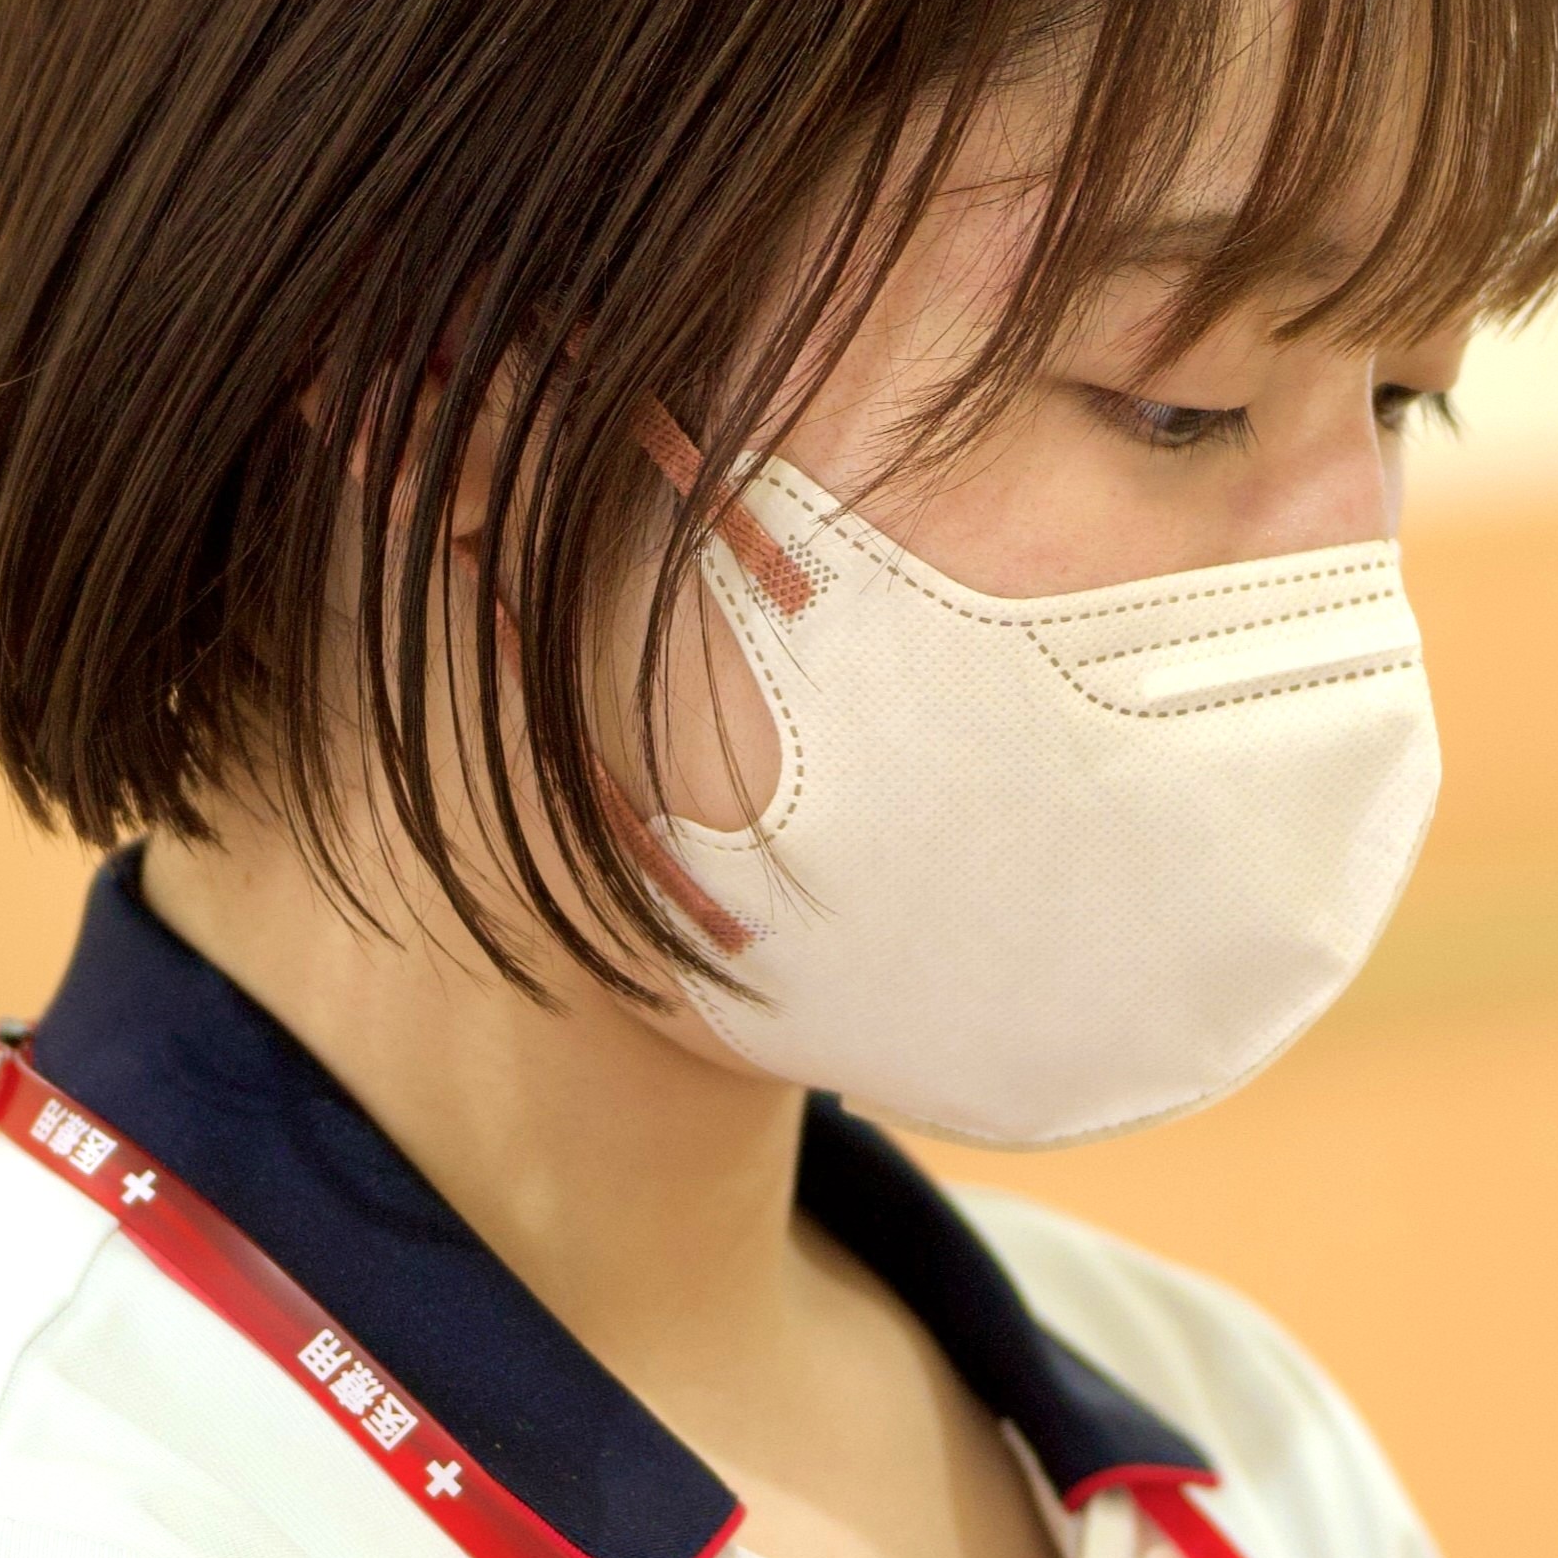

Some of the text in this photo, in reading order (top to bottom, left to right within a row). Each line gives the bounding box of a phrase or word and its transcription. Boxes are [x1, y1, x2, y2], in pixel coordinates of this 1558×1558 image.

[30, 1098, 118, 1175] 医療用
[297, 1328, 419, 1451] 医療用
